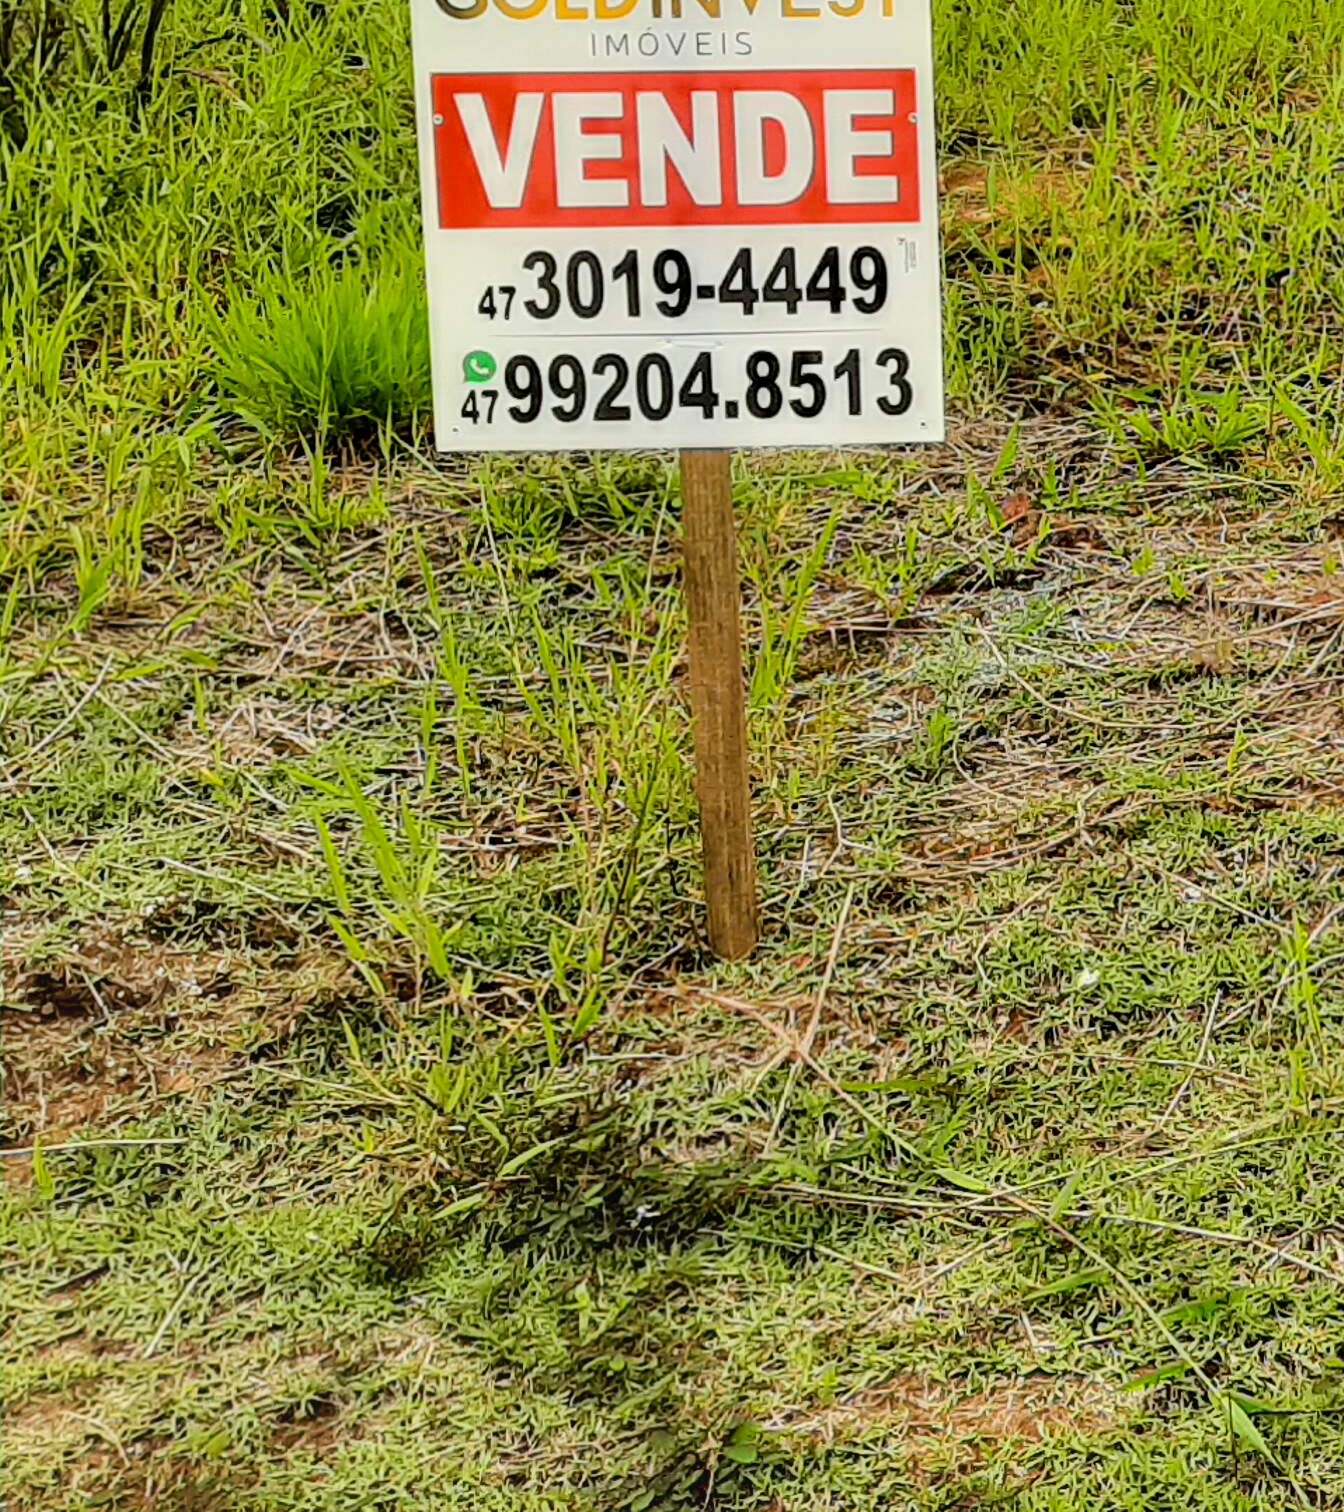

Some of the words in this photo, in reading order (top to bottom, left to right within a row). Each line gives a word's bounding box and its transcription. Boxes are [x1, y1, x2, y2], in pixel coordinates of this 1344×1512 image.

[590, 27, 754, 56] IMÓVEIS
[453, 88, 898, 209] VENDE
[477, 285, 516, 321] 47
[522, 245, 889, 320] 3019-4449
[460, 390, 499, 425] 47
[503, 348, 914, 423] 99204.8513
